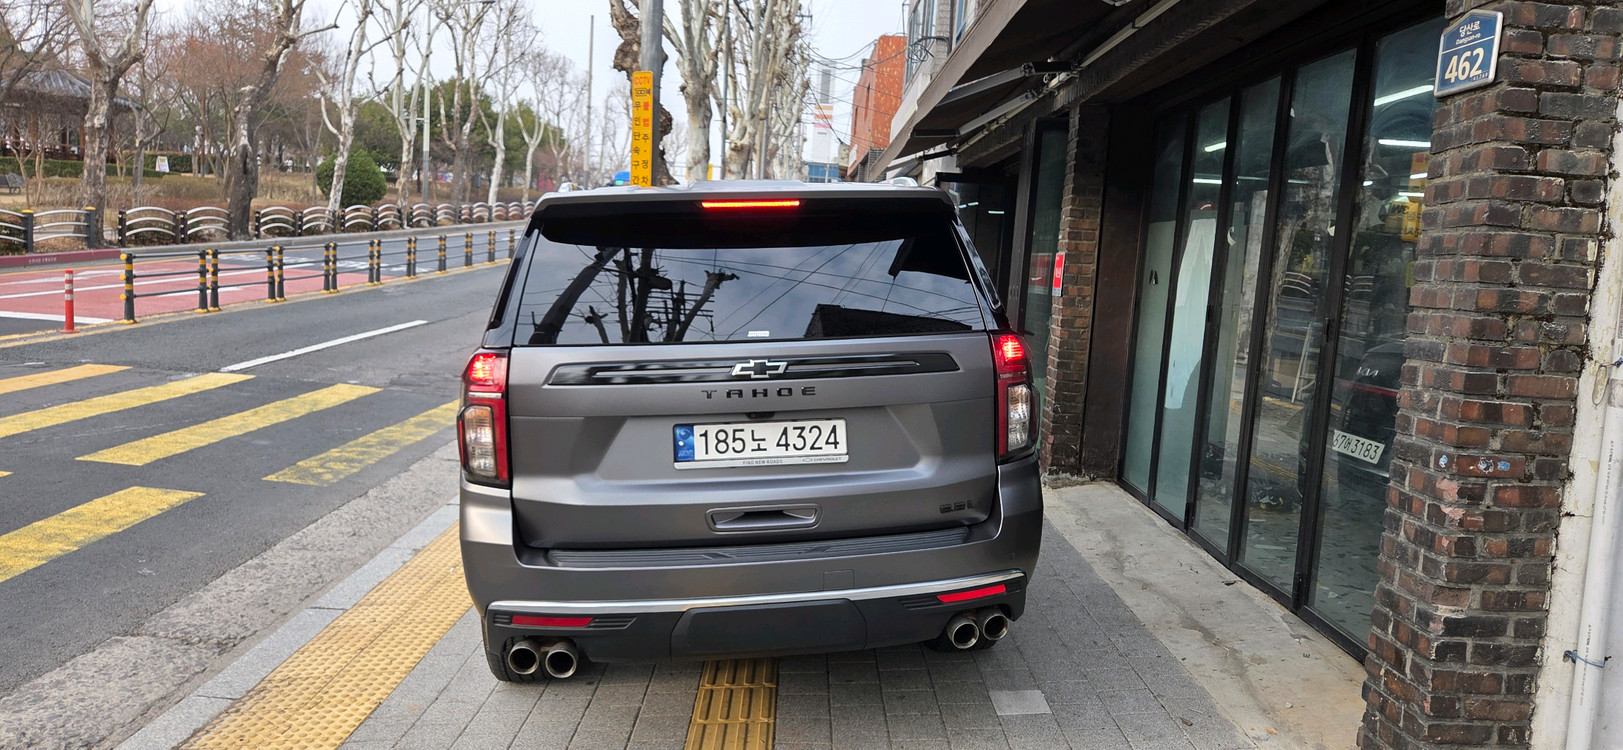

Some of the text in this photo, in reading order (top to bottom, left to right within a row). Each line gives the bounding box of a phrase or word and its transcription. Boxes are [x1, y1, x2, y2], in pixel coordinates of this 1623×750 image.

[1459, 20, 1481, 37] 당산로
[1444, 47, 1485, 84] 462
[634, 76, 650, 86] CCTV
[701, 386, 817, 400] TAHOE
[699, 424, 840, 456] 185노 4324
